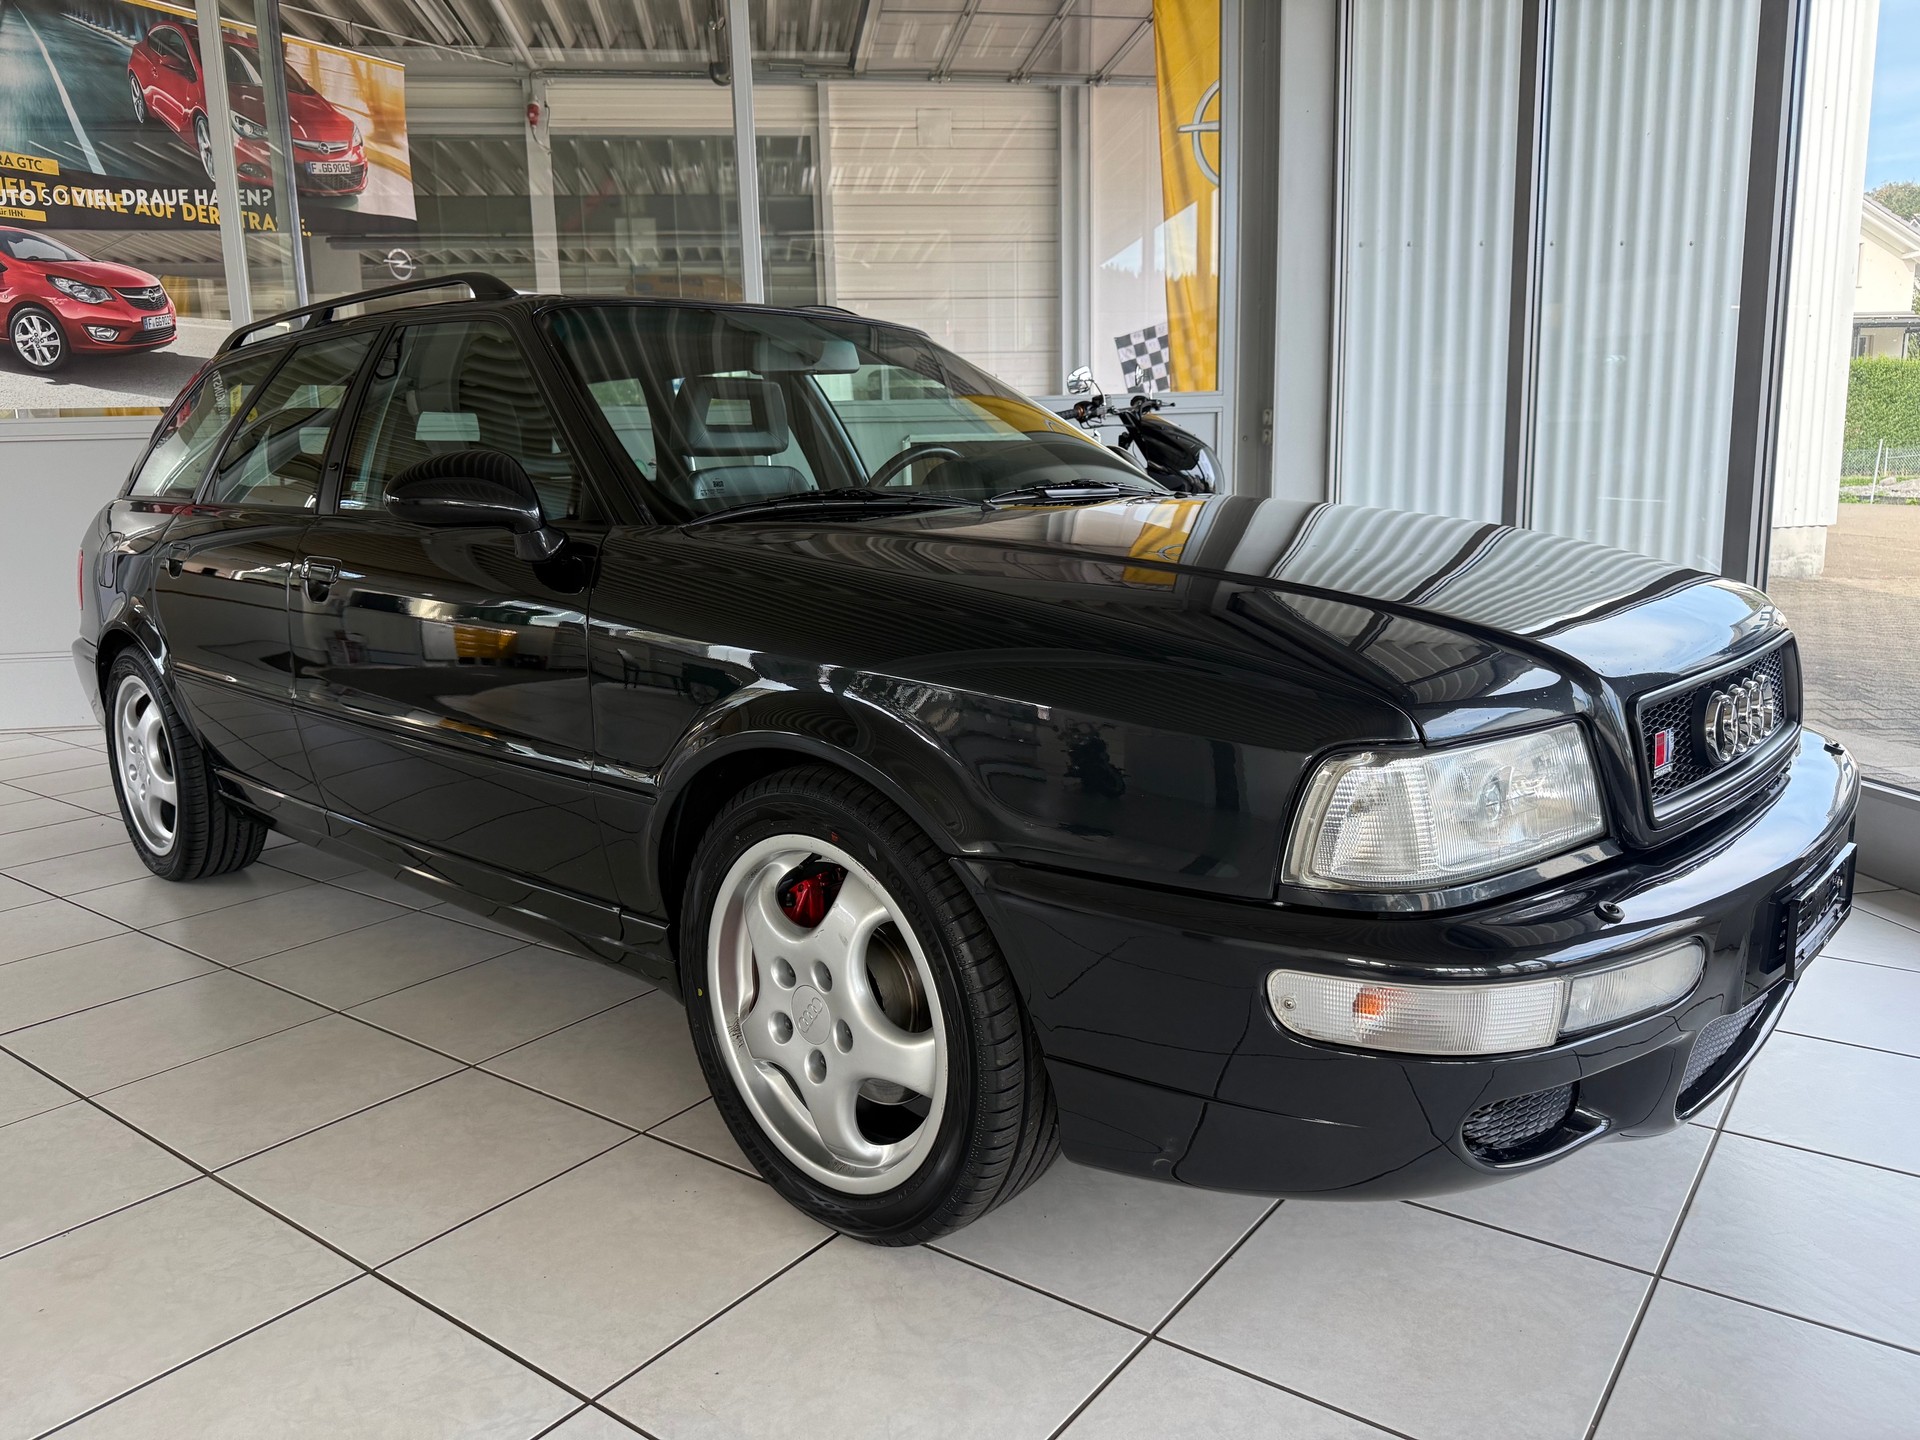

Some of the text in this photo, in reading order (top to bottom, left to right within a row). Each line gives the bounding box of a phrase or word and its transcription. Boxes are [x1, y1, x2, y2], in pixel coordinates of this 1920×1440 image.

[17, 156, 43, 171] GTC
[121, 189, 189, 206] DRAUF
[194, 188, 272, 207] HAEN?
[134, 197, 176, 219] AUF
[182, 202, 221, 226] DER
